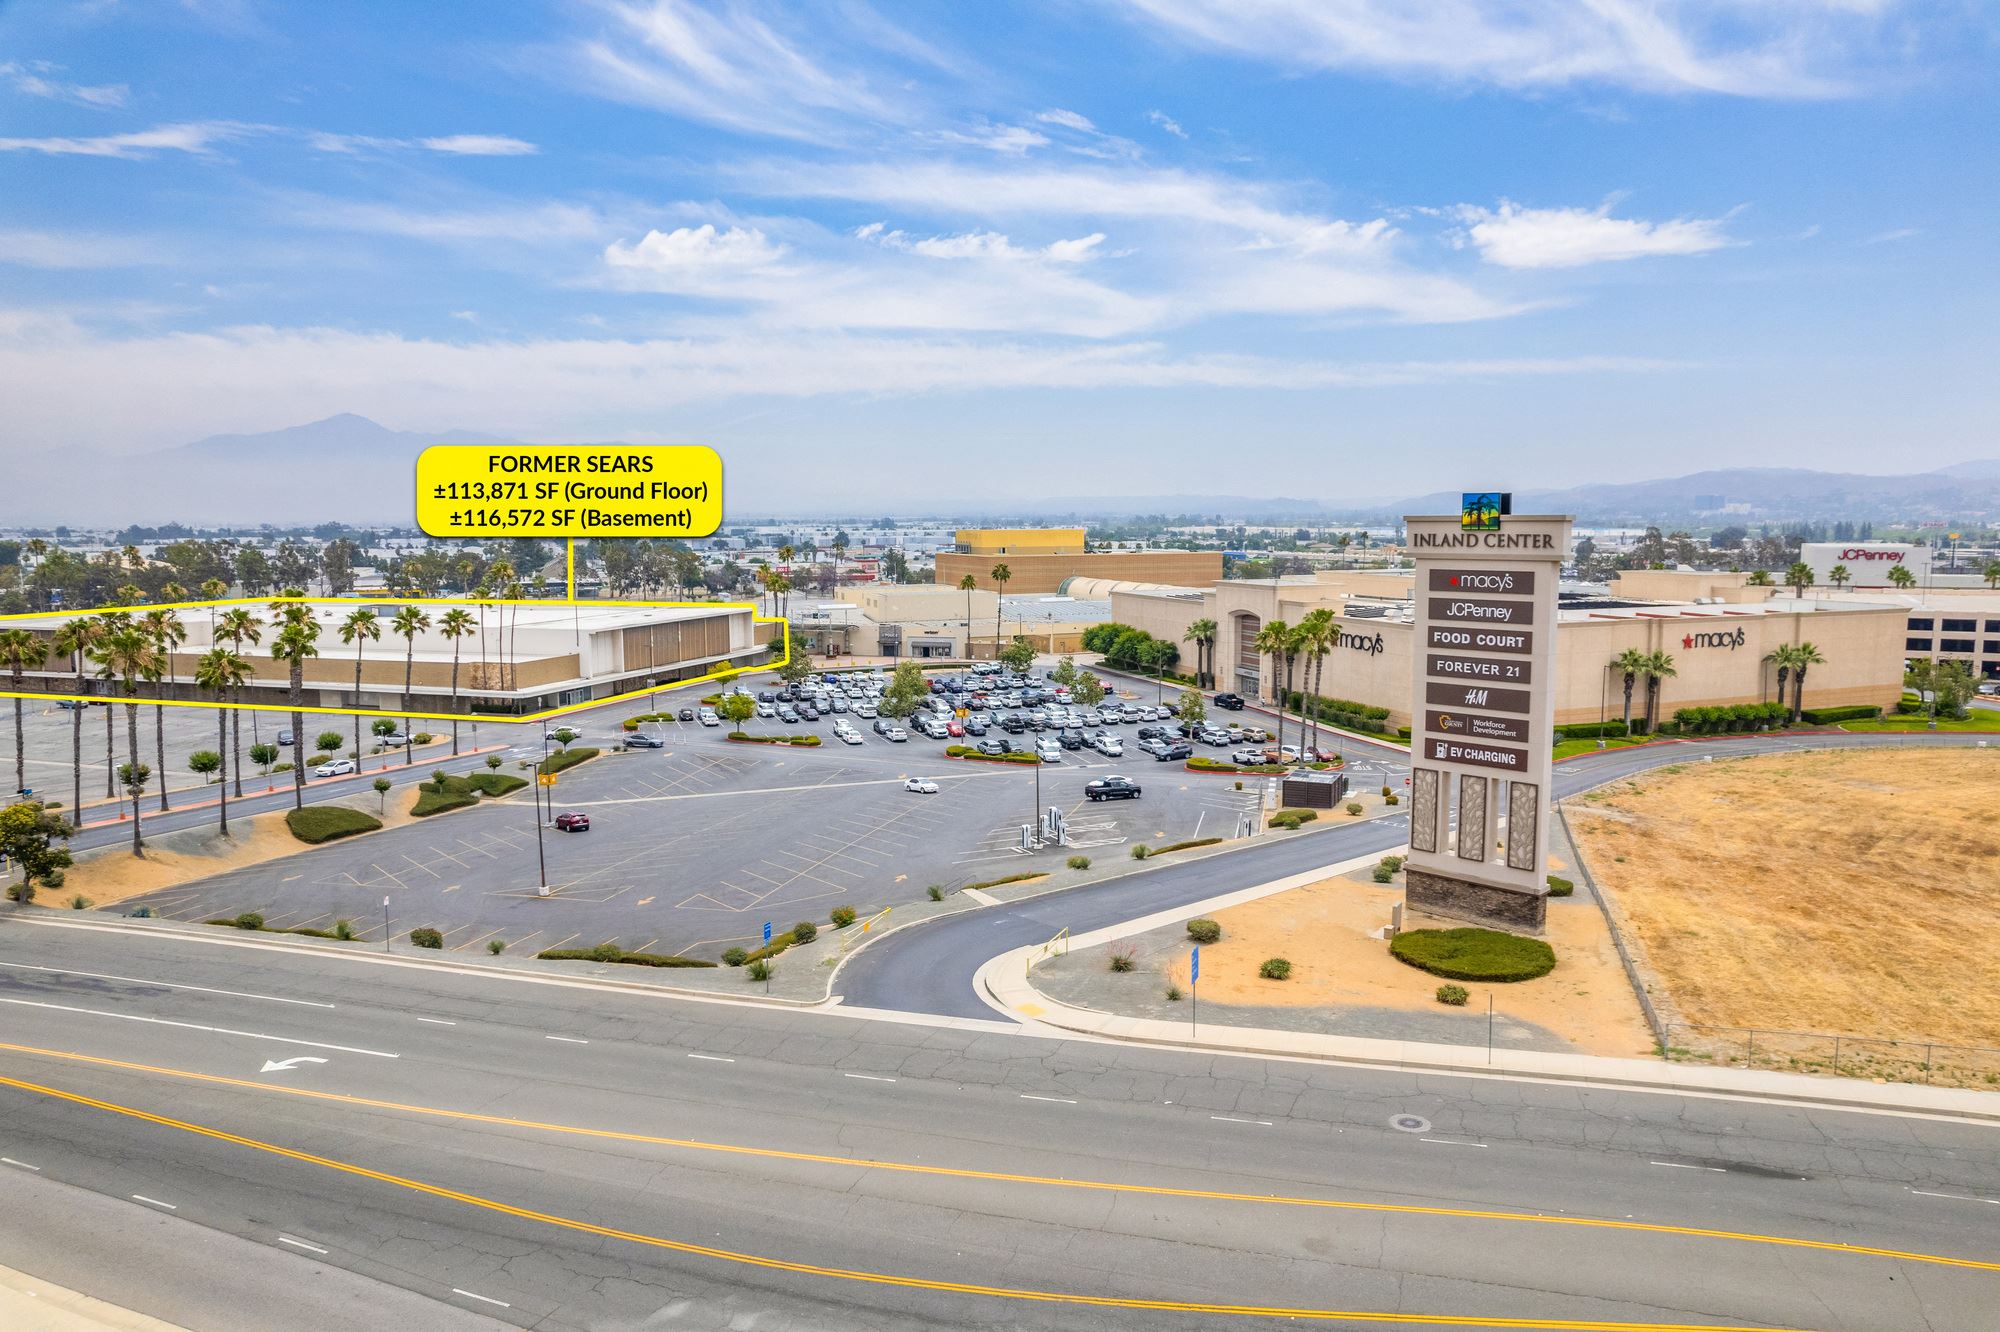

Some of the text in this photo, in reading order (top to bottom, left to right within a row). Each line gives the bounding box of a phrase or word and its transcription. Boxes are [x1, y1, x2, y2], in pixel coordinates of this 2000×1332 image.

[1413, 533, 1555, 549] INLAND CENTER
[1837, 548, 1906, 563] JCPenney
[1460, 573, 1513, 592] macy's
[1447, 602, 1512, 621] JCPenney
[1340, 632, 1383, 656] macy's
[1433, 631, 1525, 648] FOOD COURT
[1694, 626, 1745, 651] macy's
[1436, 660, 1520, 677] FOREVER 21
[1464, 688, 1489, 706] H&M
[1472, 719, 1506, 730] Workforce
[1473, 726, 1517, 737] Development
[1450, 746, 1516, 765] EV CHARGING
